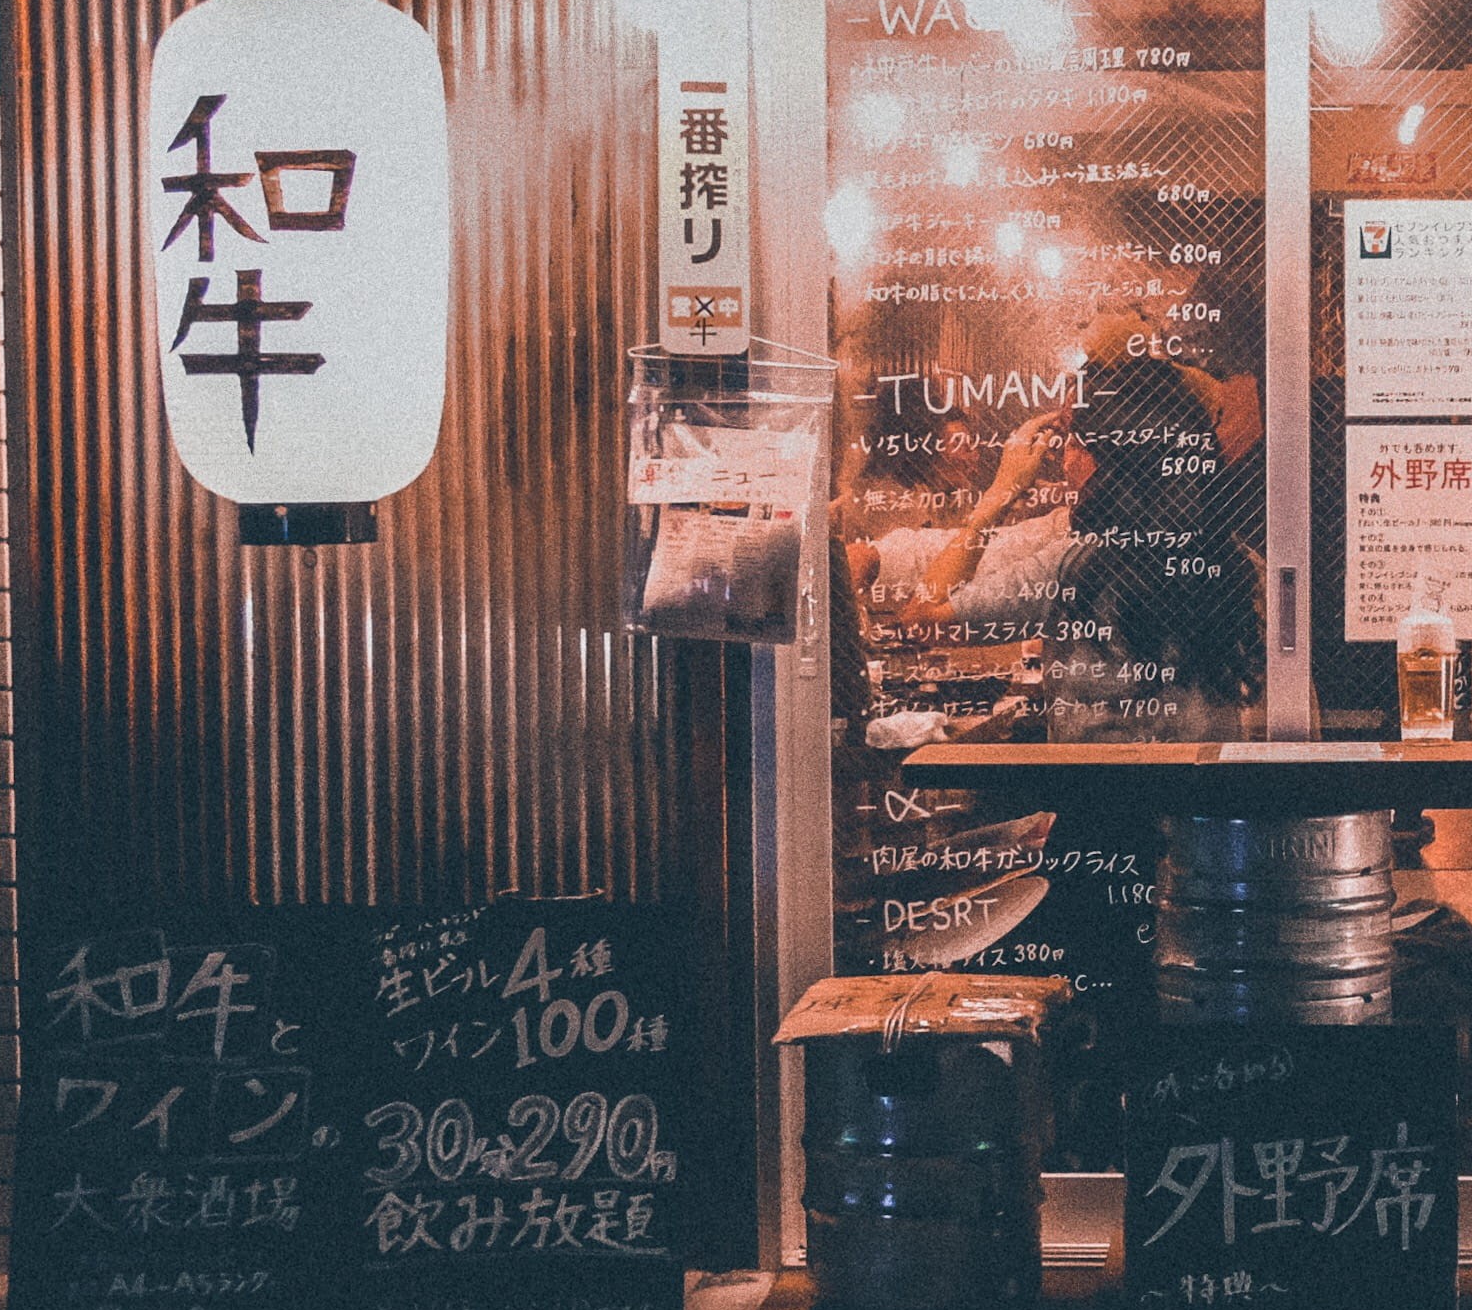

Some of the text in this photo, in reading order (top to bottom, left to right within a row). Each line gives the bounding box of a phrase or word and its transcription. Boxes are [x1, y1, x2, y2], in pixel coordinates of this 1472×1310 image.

[1136, 46, 1191, 68] 780円
[1024, 132, 1074, 149] 680円
[680, 81, 728, 264] 一番搾り
[1157, 184, 1210, 203] 680円
[1169, 244, 1222, 265] 680円
[1395, 247, 1465, 259] ランキング
[161, 94, 357, 455] 和牛
[1165, 303, 1221, 323] 480円
[690, 317, 717, 347] 牛
[877, 369, 1091, 415] TUMAMI
[1160, 456, 1217, 477] 580円
[1370, 457, 1472, 491] 外野席
[863, 484, 1021, 512] 無添加オリブ
[1165, 557, 1222, 578] 580円
[871, 580, 1077, 605] 自家製ピス 480円
[870, 620, 1112, 644] さっぱりトマトスライス 380円
[1116, 662, 1175, 683] 480円
[1120, 699, 1177, 718] 780円
[872, 845, 1140, 875] 肉屋の和牛ガーリックライス
[883, 896, 1000, 933] DESRT
[46, 946, 302, 1061] 和牛と
[56, 1077, 341, 1148] ワインの
[364, 1091, 678, 1183] 30分290円
[1142, 1122, 1436, 1251] 外野席
[49, 1171, 303, 1232] 大衆酒場
[364, 1187, 672, 1255] 飲み放題
